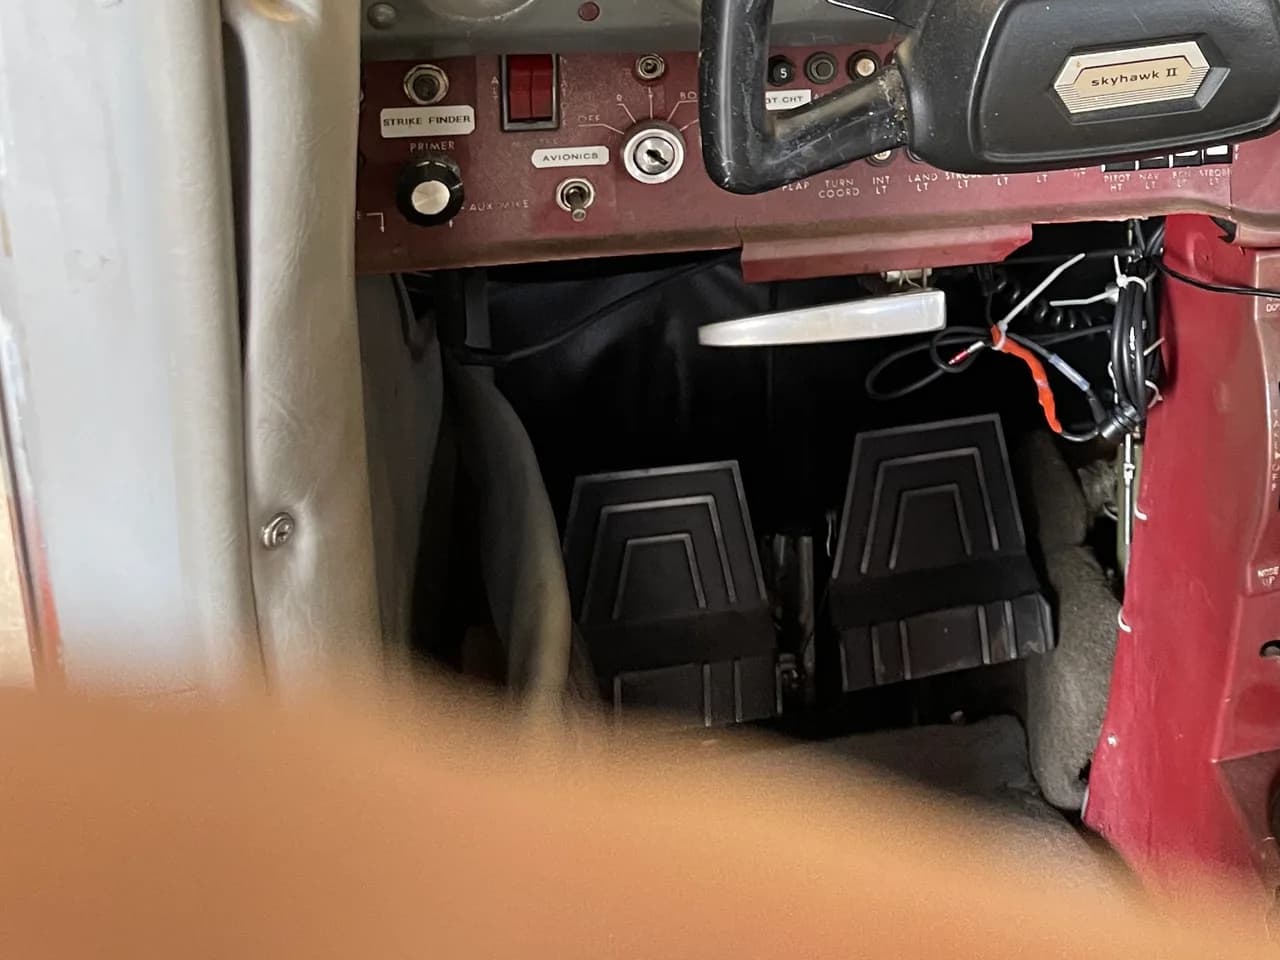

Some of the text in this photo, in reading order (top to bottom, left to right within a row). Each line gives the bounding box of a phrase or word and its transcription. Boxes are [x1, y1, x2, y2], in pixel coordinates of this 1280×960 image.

[1091, 67, 1178, 88] skyhawk II
[383, 115, 471, 128] STRIKE FINDER
[409, 140, 455, 153] PRIMER
[542, 152, 599, 162] AVIONICS
[872, 175, 890, 185] INT
[908, 172, 938, 183] LAND
[1104, 174, 1130, 183] PITOT
[825, 178, 854, 188] TURN
[818, 188, 860, 199] COORD
[469, 203, 493, 212] AUX
[1257, 567, 1280, 577] NOSE
